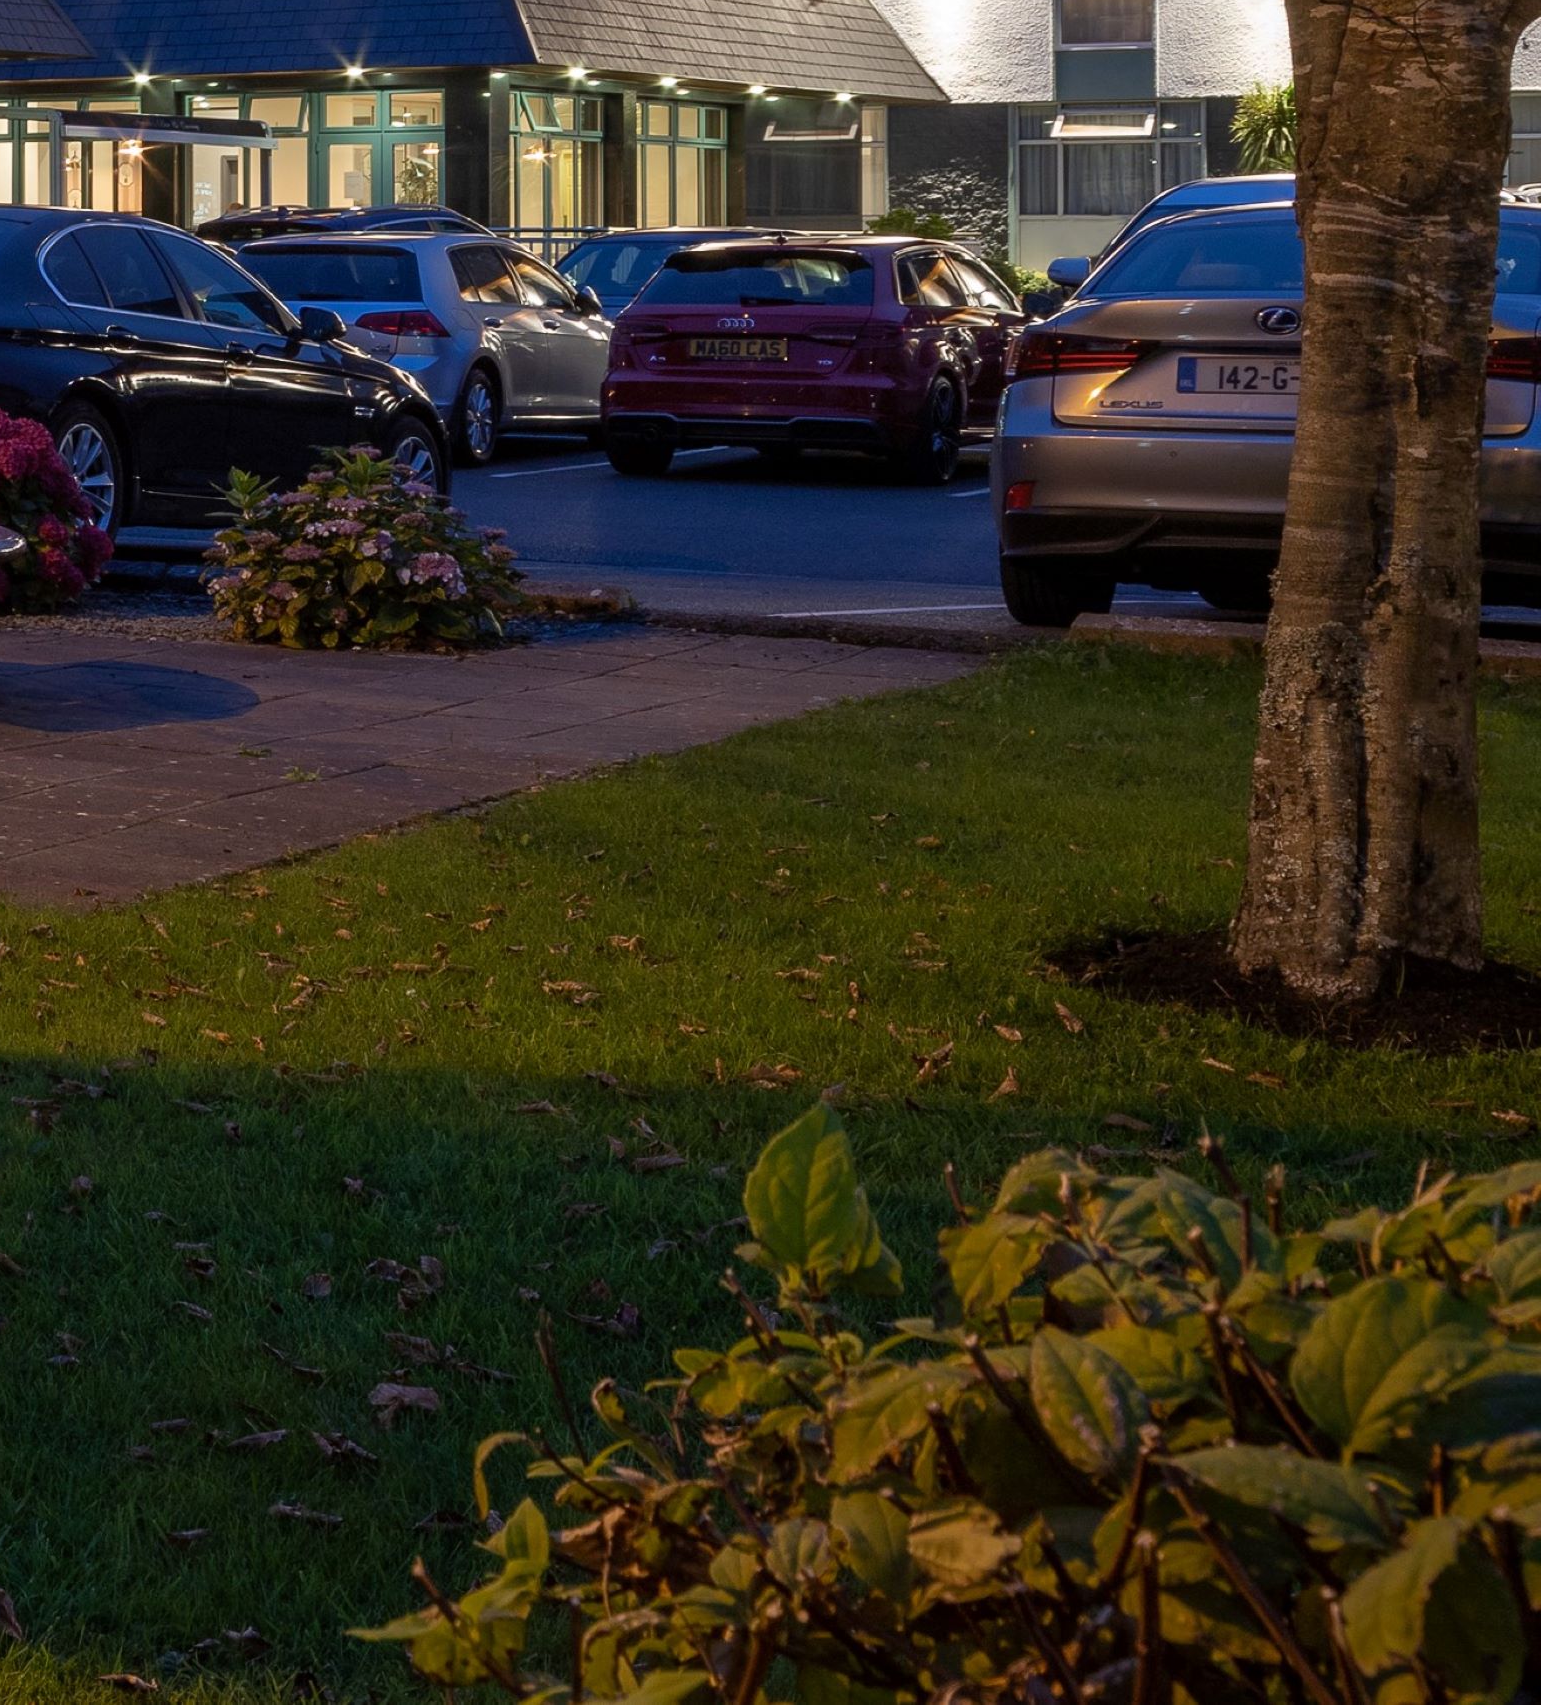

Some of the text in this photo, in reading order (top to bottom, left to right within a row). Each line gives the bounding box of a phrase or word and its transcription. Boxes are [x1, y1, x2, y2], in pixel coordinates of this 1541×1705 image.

[695, 340, 781, 356] MA60 CAS
[1218, 365, 1301, 391] 142-G-
[1099, 399, 1165, 410] LEXUS
